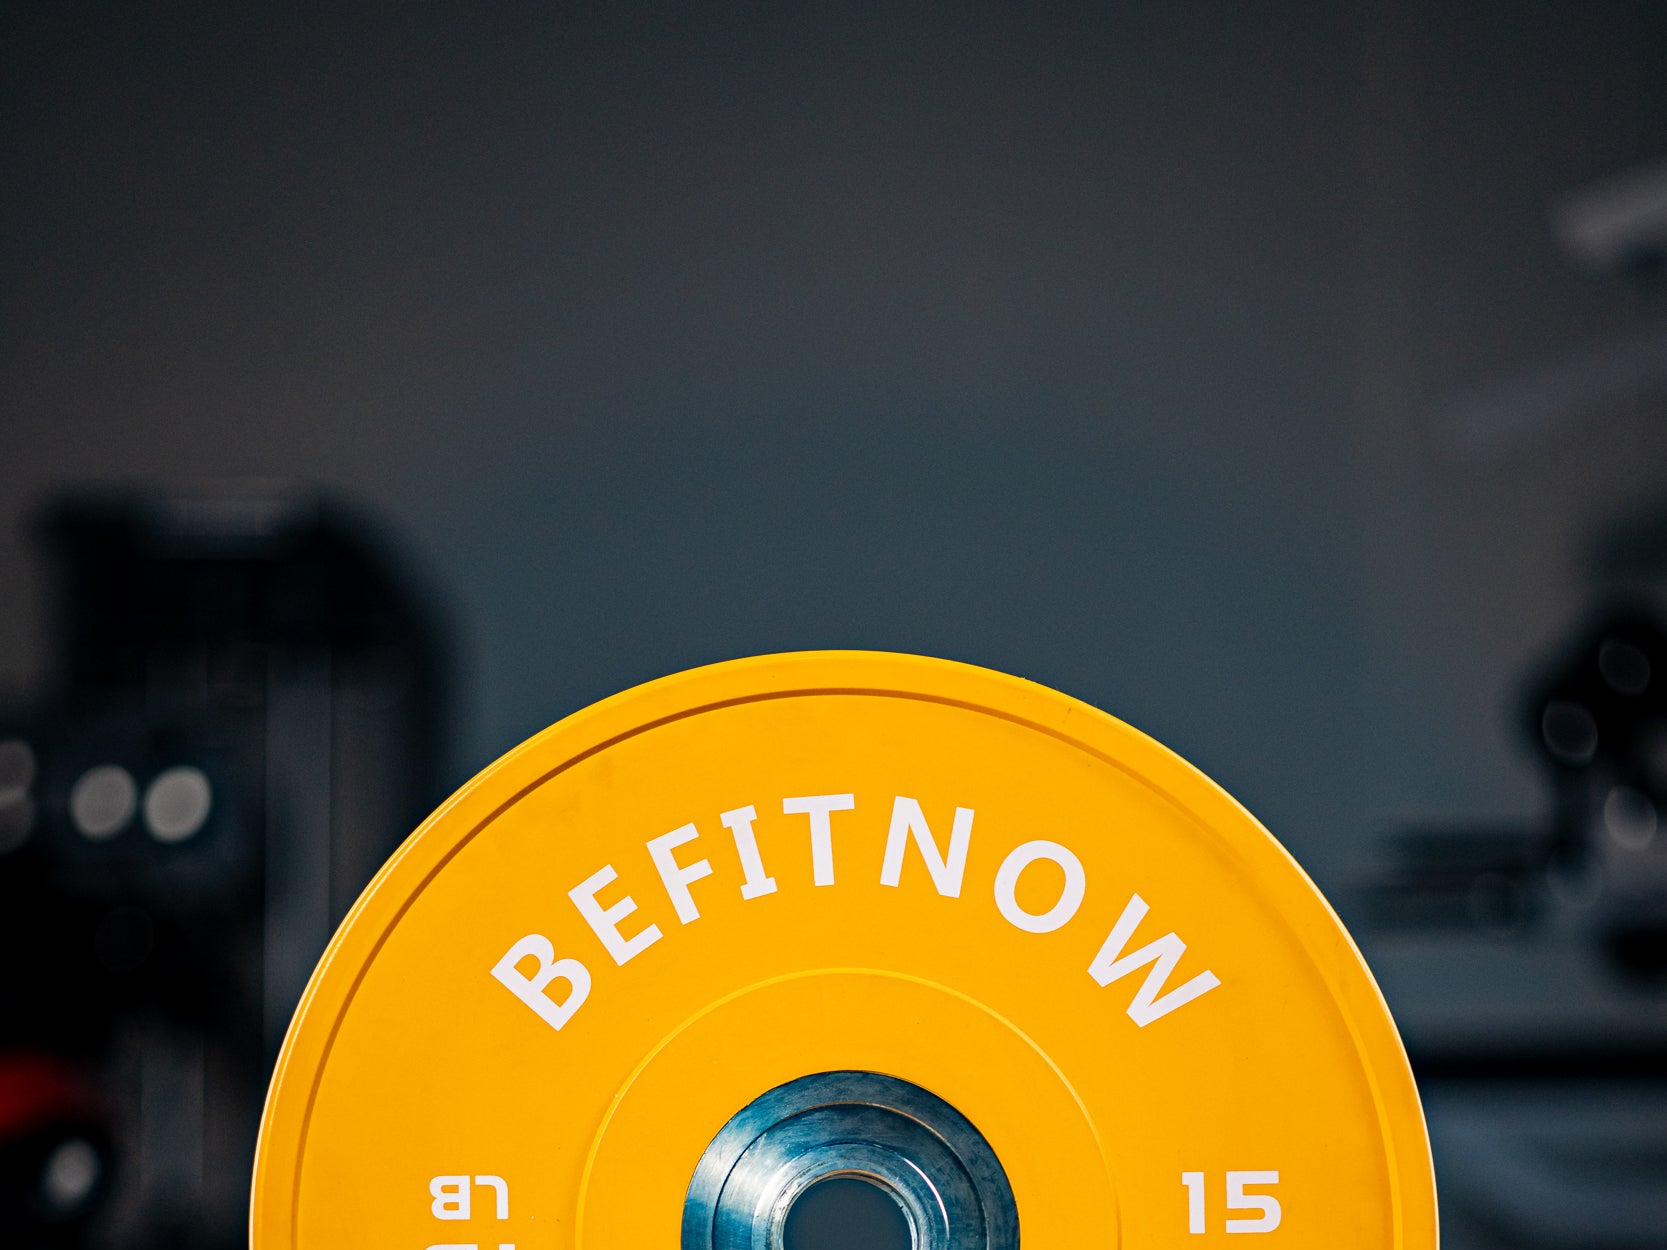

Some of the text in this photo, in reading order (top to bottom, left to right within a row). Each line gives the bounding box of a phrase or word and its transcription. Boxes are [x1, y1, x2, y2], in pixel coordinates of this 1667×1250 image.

[490, 793, 1221, 1031] BEFITNOW
[429, 1175, 509, 1220] LB
[1181, 1170, 1281, 1234] 15
